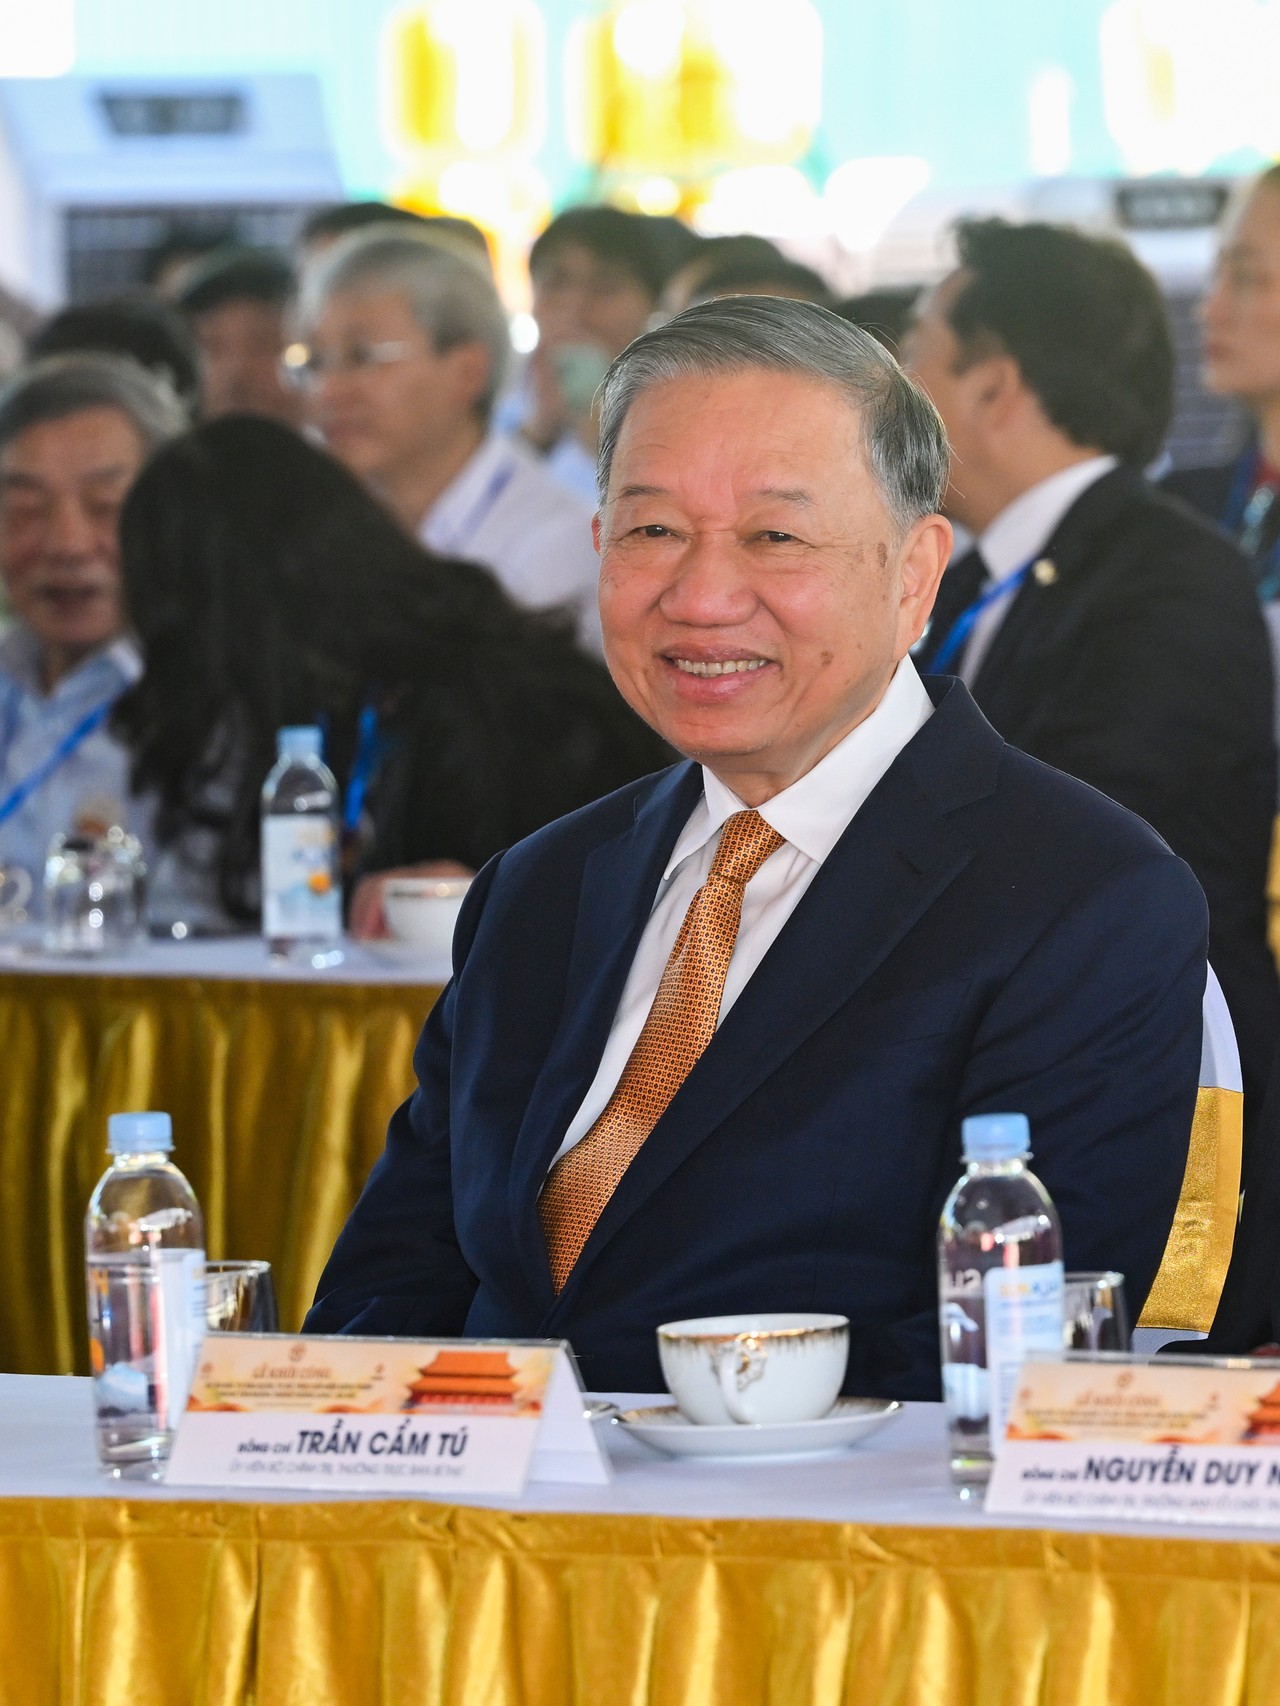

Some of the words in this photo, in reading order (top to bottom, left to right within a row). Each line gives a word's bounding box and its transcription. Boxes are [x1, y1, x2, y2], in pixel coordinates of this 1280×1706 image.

[438, 1425, 467, 1457] TÚ
[1084, 1444, 1197, 1483] NGUYỄN
[1203, 1459, 1261, 1485] DUY
